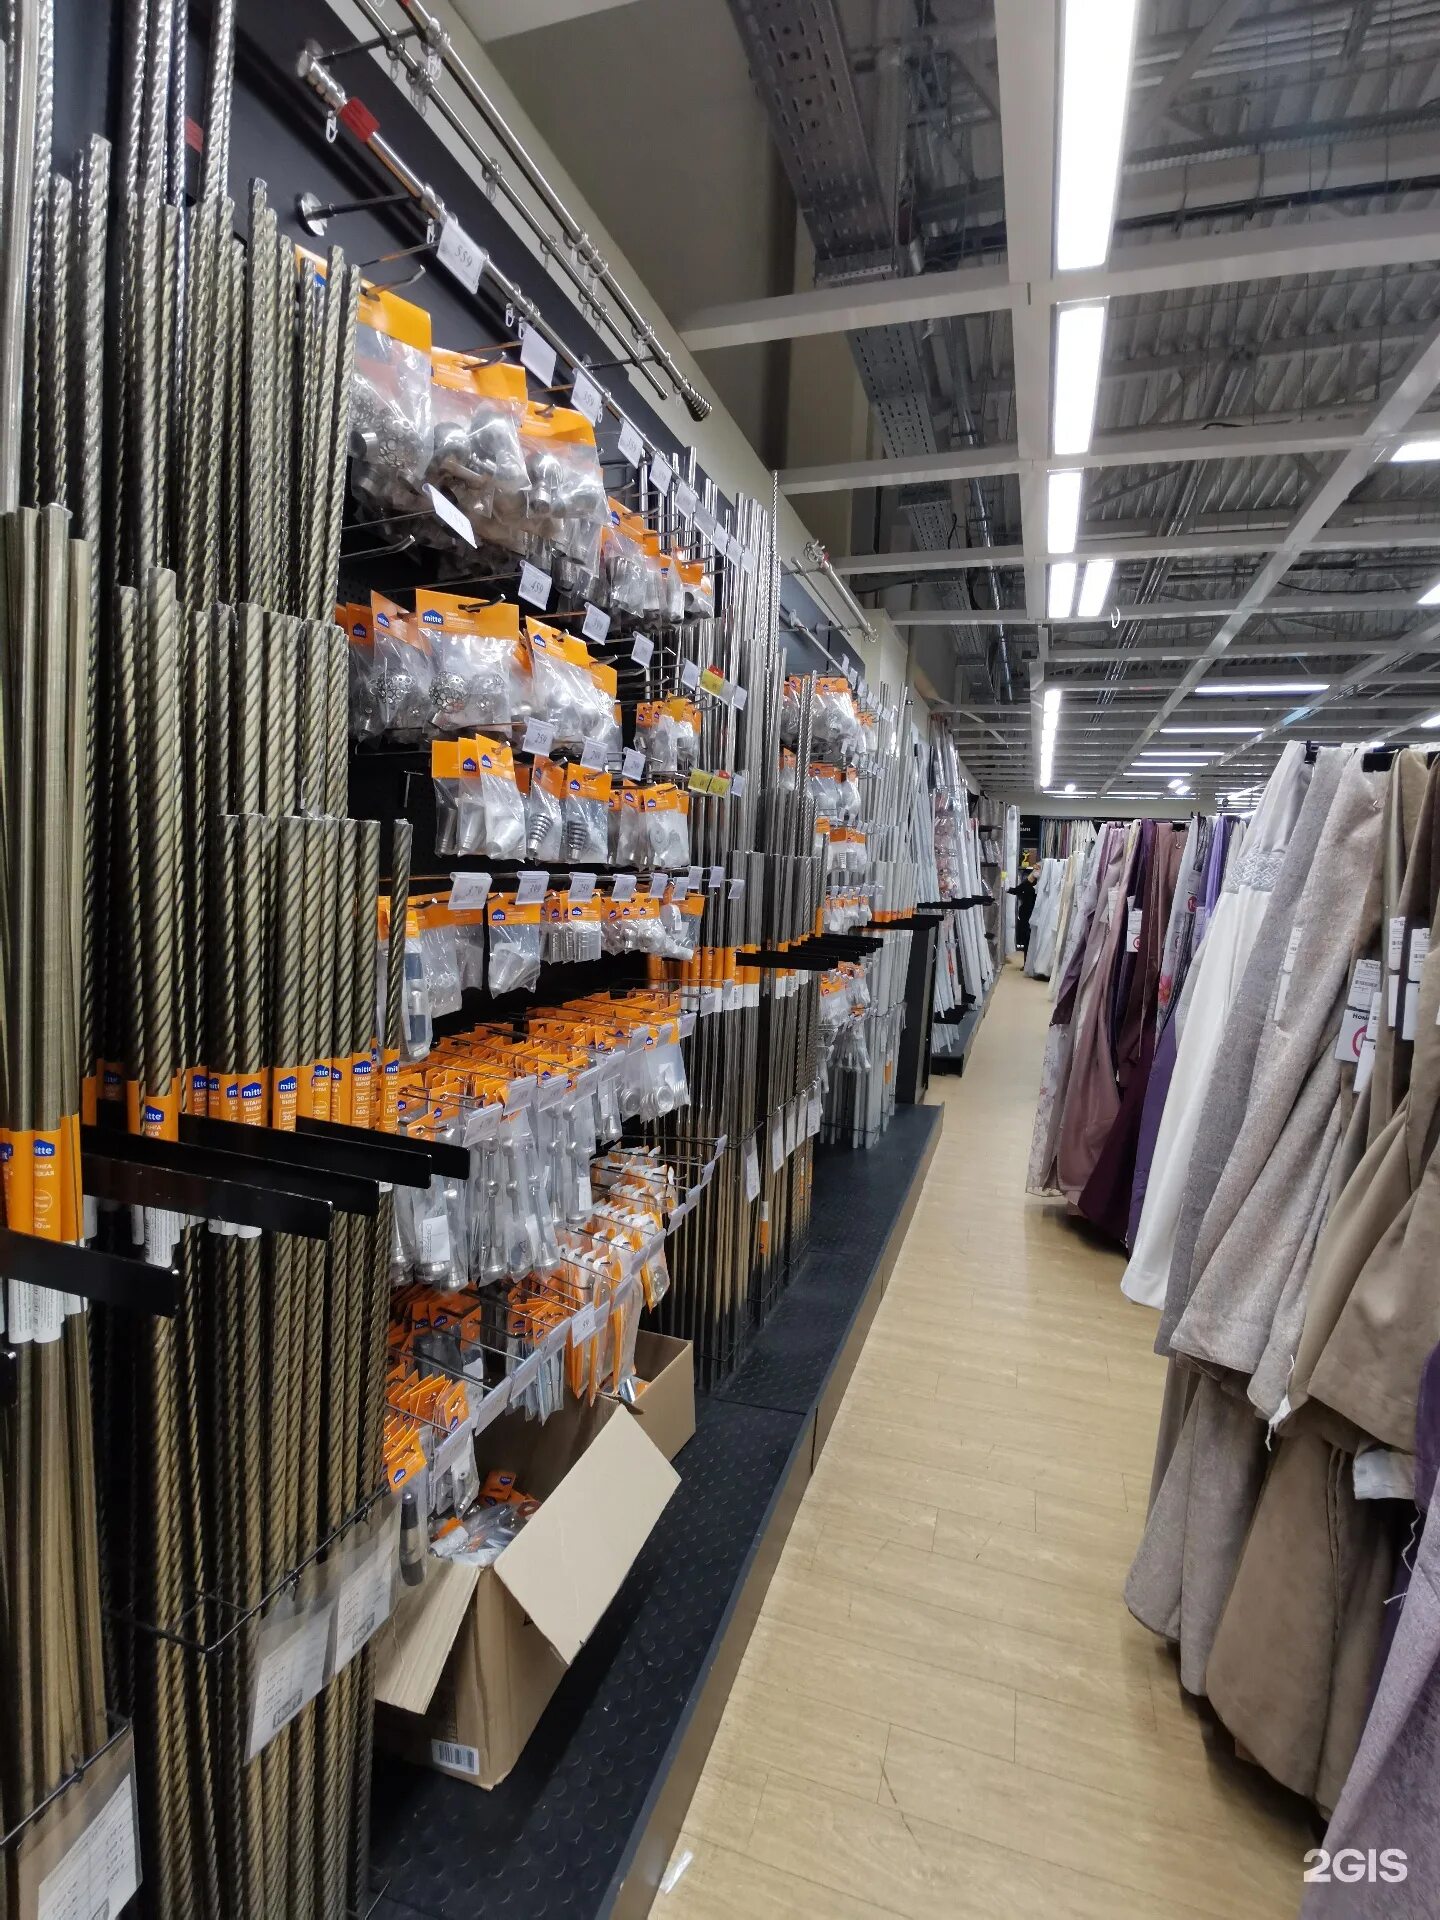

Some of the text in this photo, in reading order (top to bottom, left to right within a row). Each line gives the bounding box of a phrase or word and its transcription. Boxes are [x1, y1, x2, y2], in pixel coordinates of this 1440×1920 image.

[530, 580, 544, 594] 459
[424, 615, 442, 624] mitte
[146, 1111, 162, 1121] itte
[34, 1145, 52, 1155] itte
